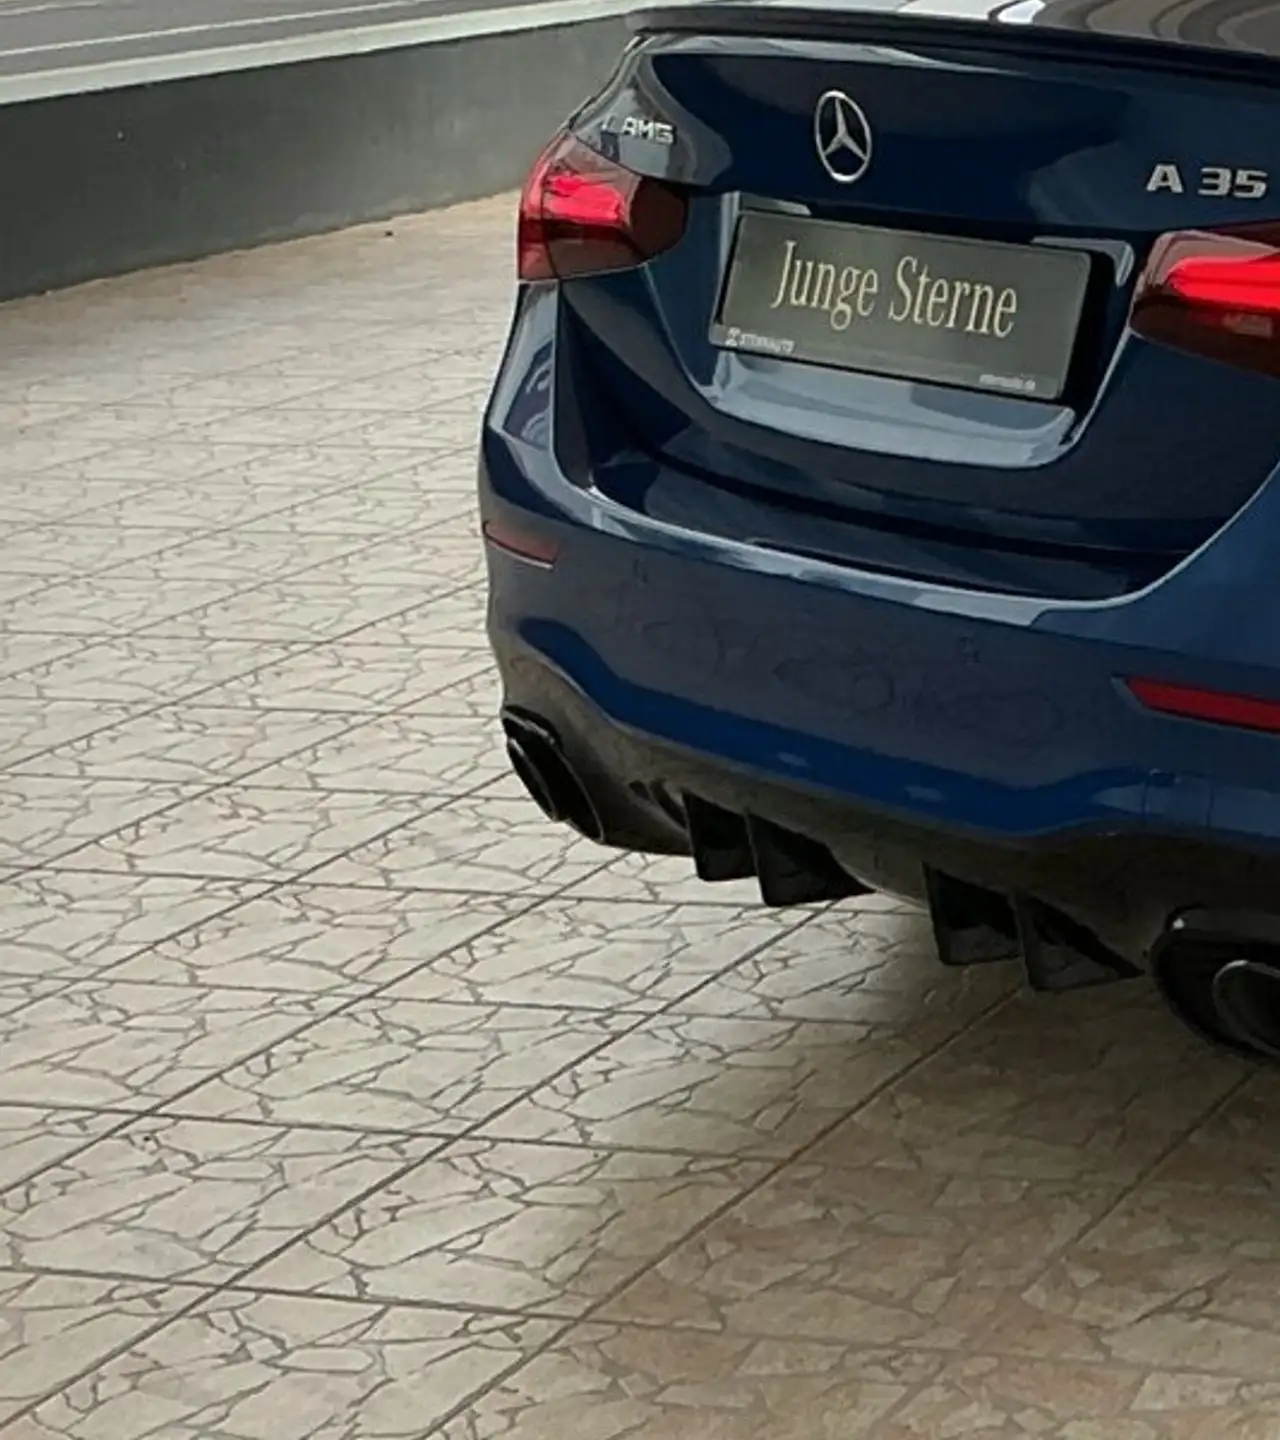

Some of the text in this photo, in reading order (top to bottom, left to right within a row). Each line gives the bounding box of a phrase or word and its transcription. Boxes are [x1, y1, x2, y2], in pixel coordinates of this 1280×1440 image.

[621, 116, 674, 144] AMG
[1146, 163, 1268, 198] A 35
[770, 239, 1018, 338] Junge Sterne
